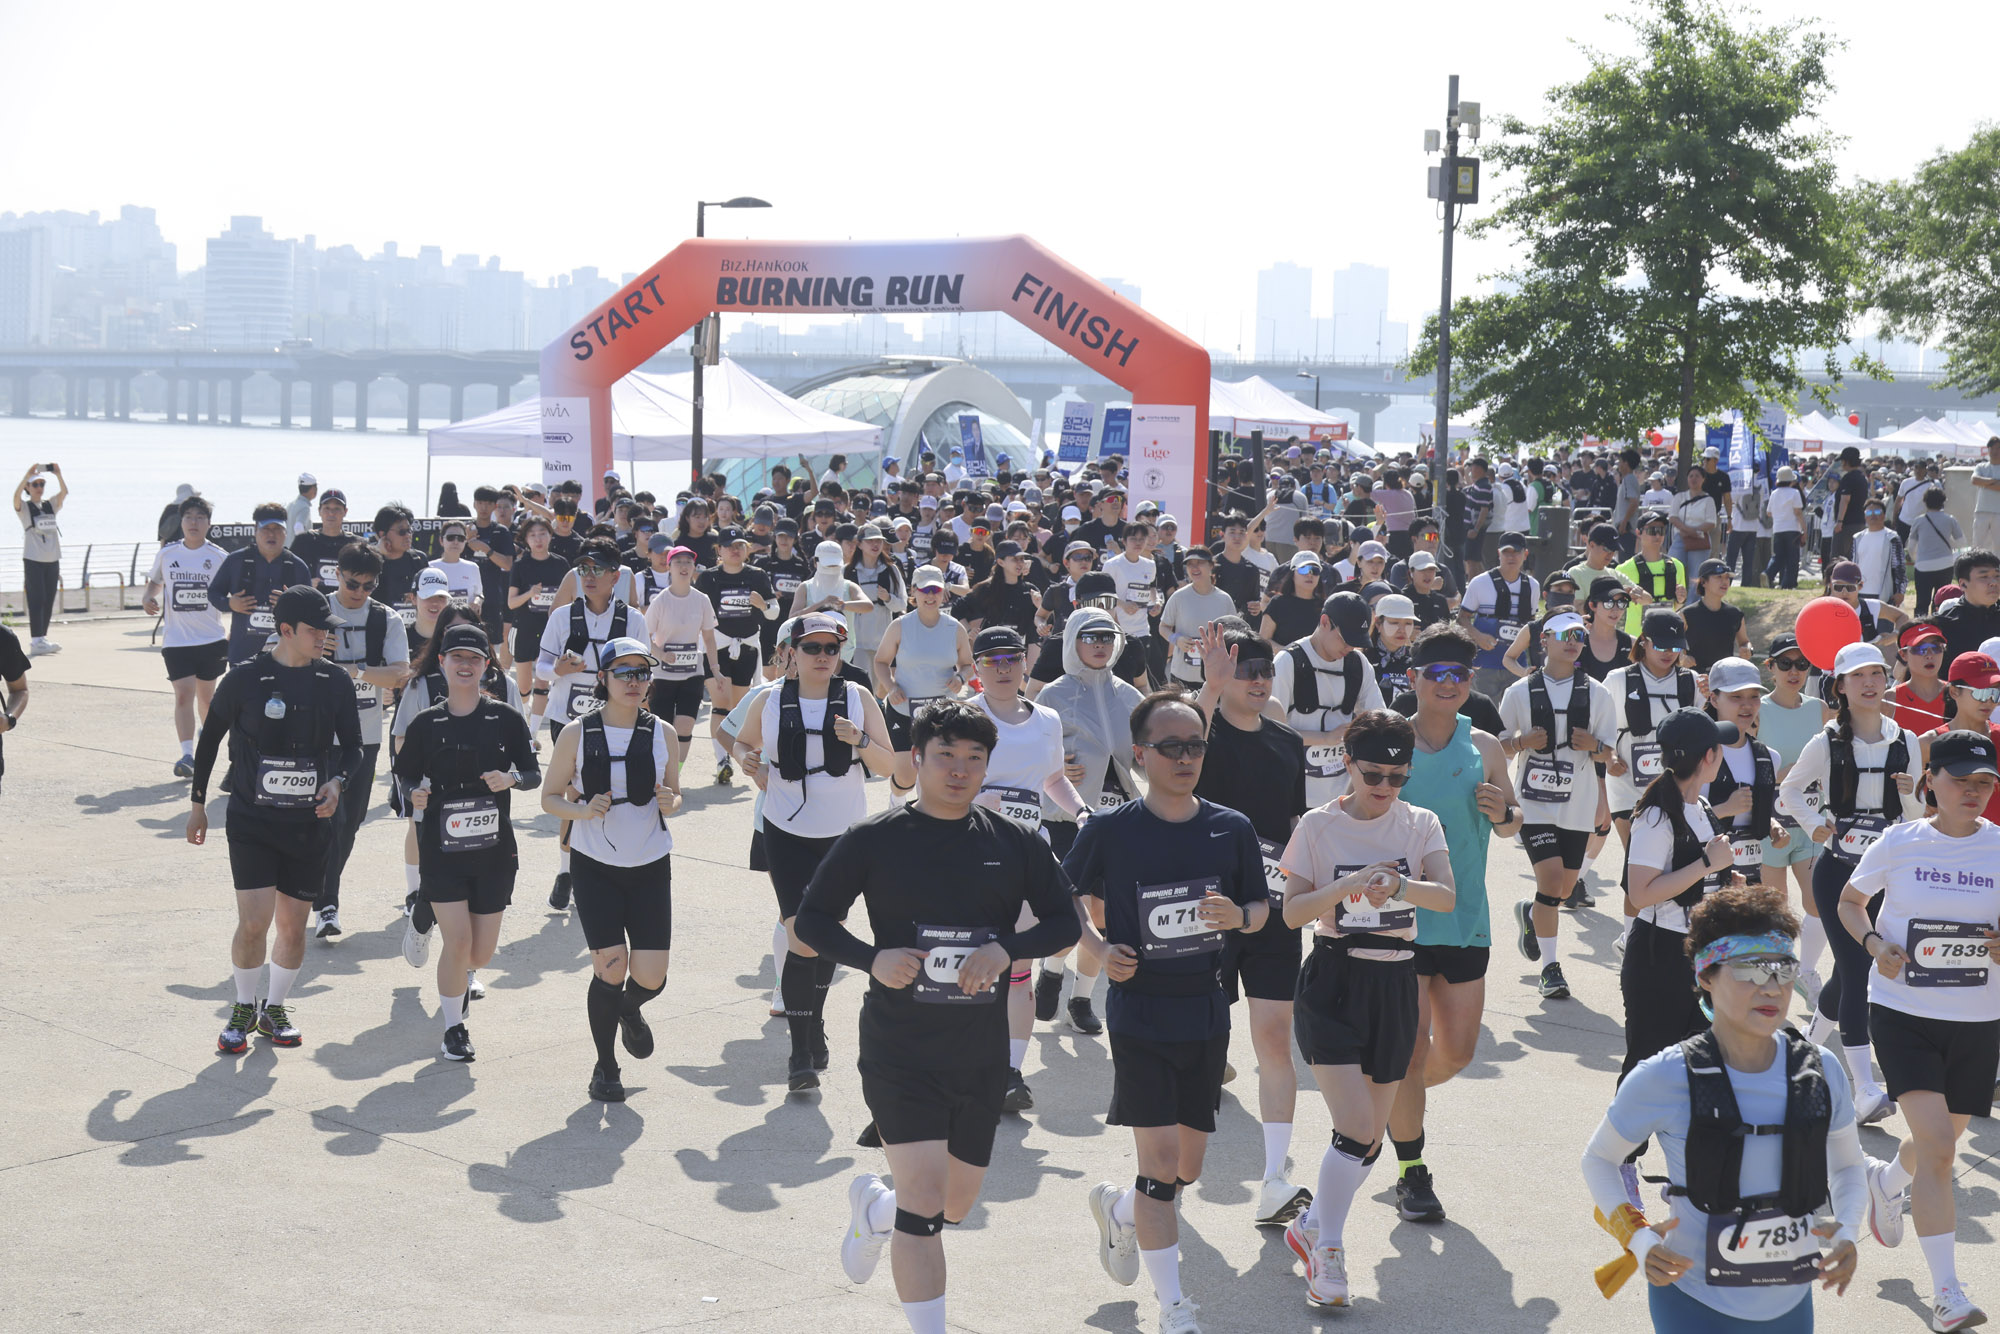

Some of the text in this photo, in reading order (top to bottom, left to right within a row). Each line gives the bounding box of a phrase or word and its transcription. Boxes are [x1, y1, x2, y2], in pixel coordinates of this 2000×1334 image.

[716, 274, 965, 306] BURNING RUN
[569, 274, 666, 361] START
[1011, 272, 1140, 367] FINISH
[1063, 416, 1093, 432] 정근식
[1760, 423, 1785, 438] 근식
[544, 460, 572, 472] Maxim
[223, 526, 256, 537] SAM
[341, 523, 374, 533] AMIK
[169, 571, 210, 583] Emirates
[186, 592, 207, 600] 7045
[676, 653, 697, 661] 7767
[354, 682, 374, 692] 067
[587, 699, 607, 709] 72
[1311, 746, 1345, 759] M 715
[268, 776, 315, 787] M 7090
[1530, 773, 1538, 781] W
[1099, 796, 1122, 807] 991
[1806, 797, 1819, 807] 00
[1005, 806, 1039, 821] 7984
[451, 813, 497, 828] W 7597
[1529, 831, 1555, 842] negative
[1844, 834, 1877, 846] W 76
[1531, 839, 1546, 848] split
[1734, 848, 1743, 856] W
[1264, 864, 1288, 882] 074
[1914, 866, 1994, 888] très bien
[1142, 888, 1174, 899] BURNING
[1173, 886, 1189, 895] RUN
[1349, 893, 1363, 903] W
[1157, 914, 1170, 926] M
[1912, 922, 1944, 931] BURNING
[921, 929, 956, 939] BURNING
[955, 931, 972, 939] RUN
[1923, 943, 1989, 958] W 7839
[933, 957, 947, 969] M
[1757, 1217, 1809, 1248] 7831
